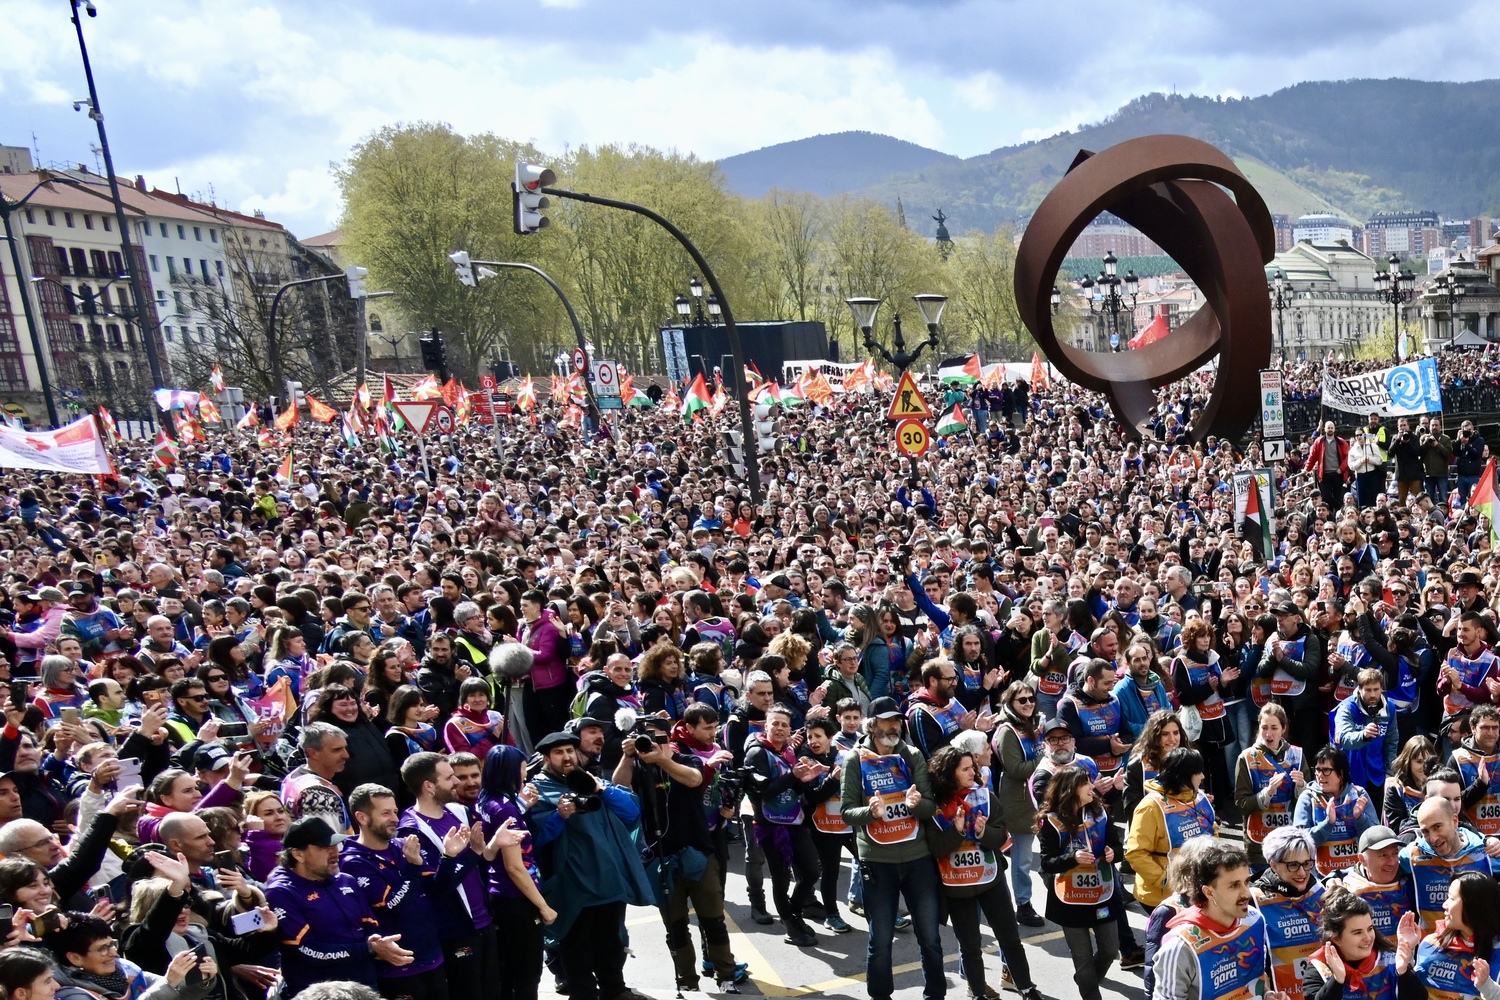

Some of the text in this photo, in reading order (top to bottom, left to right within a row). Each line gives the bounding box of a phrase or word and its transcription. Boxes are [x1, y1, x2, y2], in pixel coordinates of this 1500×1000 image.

[903, 432, 922, 444] 30
[1046, 673, 1064, 684] 2530
[1090, 724, 1106, 732] gara
[866, 772, 892, 780] Euskara
[870, 777, 894, 790] gara
[1266, 814, 1289, 826] 3436
[874, 822, 912, 835] 24.korrika
[1182, 826, 1200, 840] gara
[1334, 843, 1358, 856] 3436
[954, 852, 980, 867] 3436
[1278, 918, 1308, 928] Euskara
[1284, 924, 1311, 939] gara
[1210, 960, 1236, 980] Euskara
[1428, 966, 1456, 980] gara
[1214, 969, 1238, 990] gara
